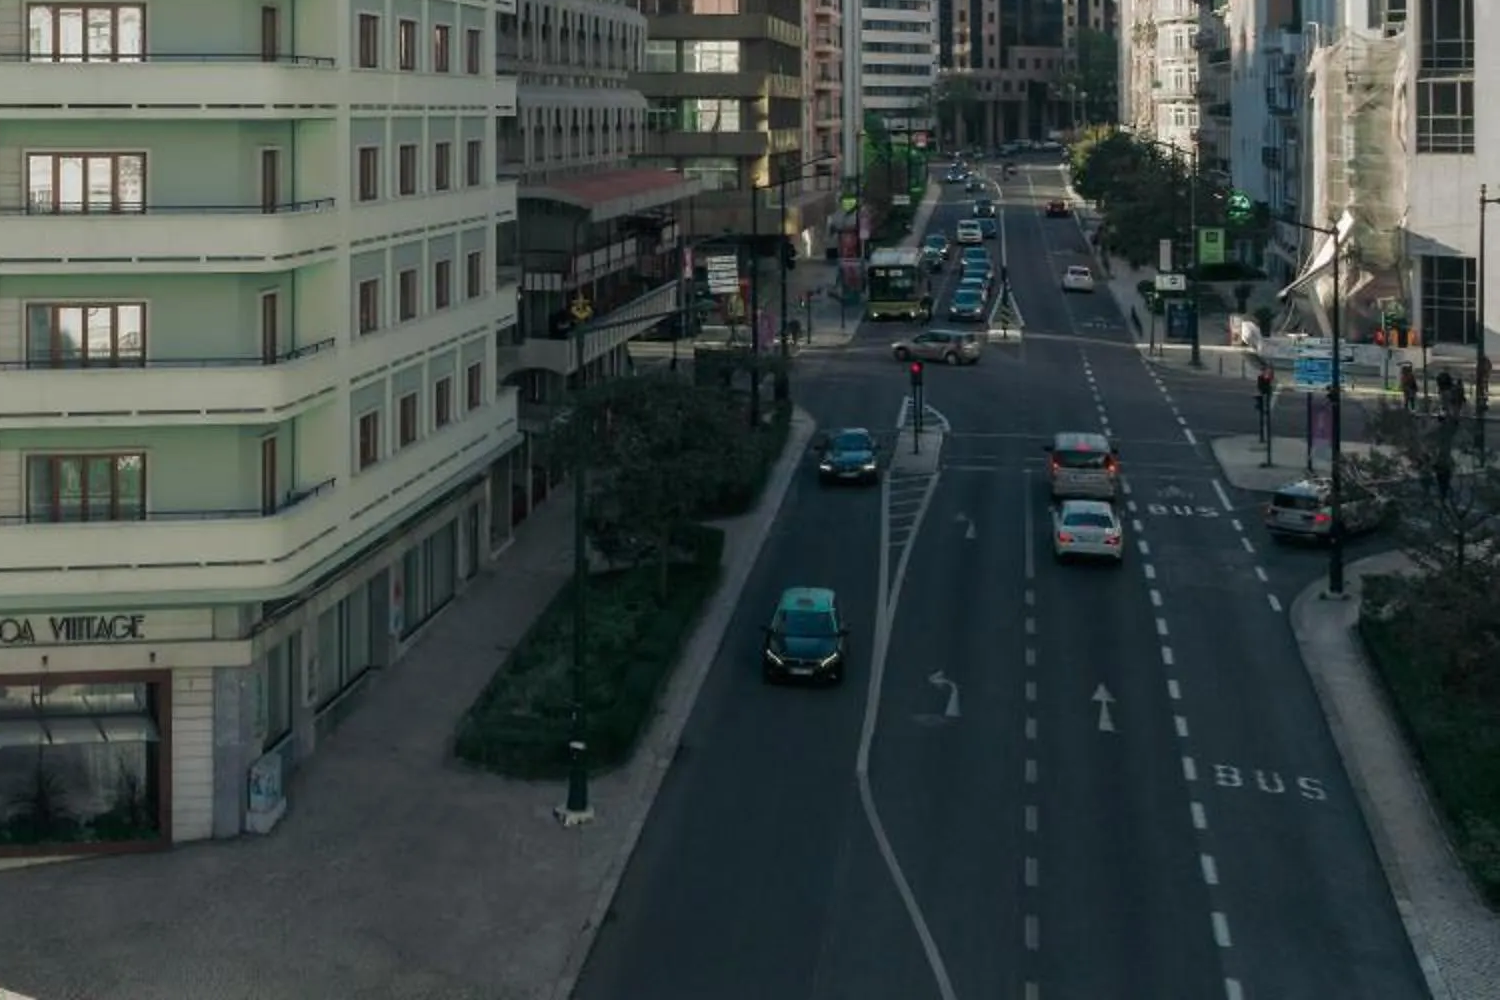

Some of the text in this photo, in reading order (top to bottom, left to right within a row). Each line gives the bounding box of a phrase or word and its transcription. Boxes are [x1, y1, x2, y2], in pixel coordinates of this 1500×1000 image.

[1147, 504, 1220, 518] BUS
[50, 615, 146, 640] VINTAGE
[1213, 763, 1327, 800] BUS
